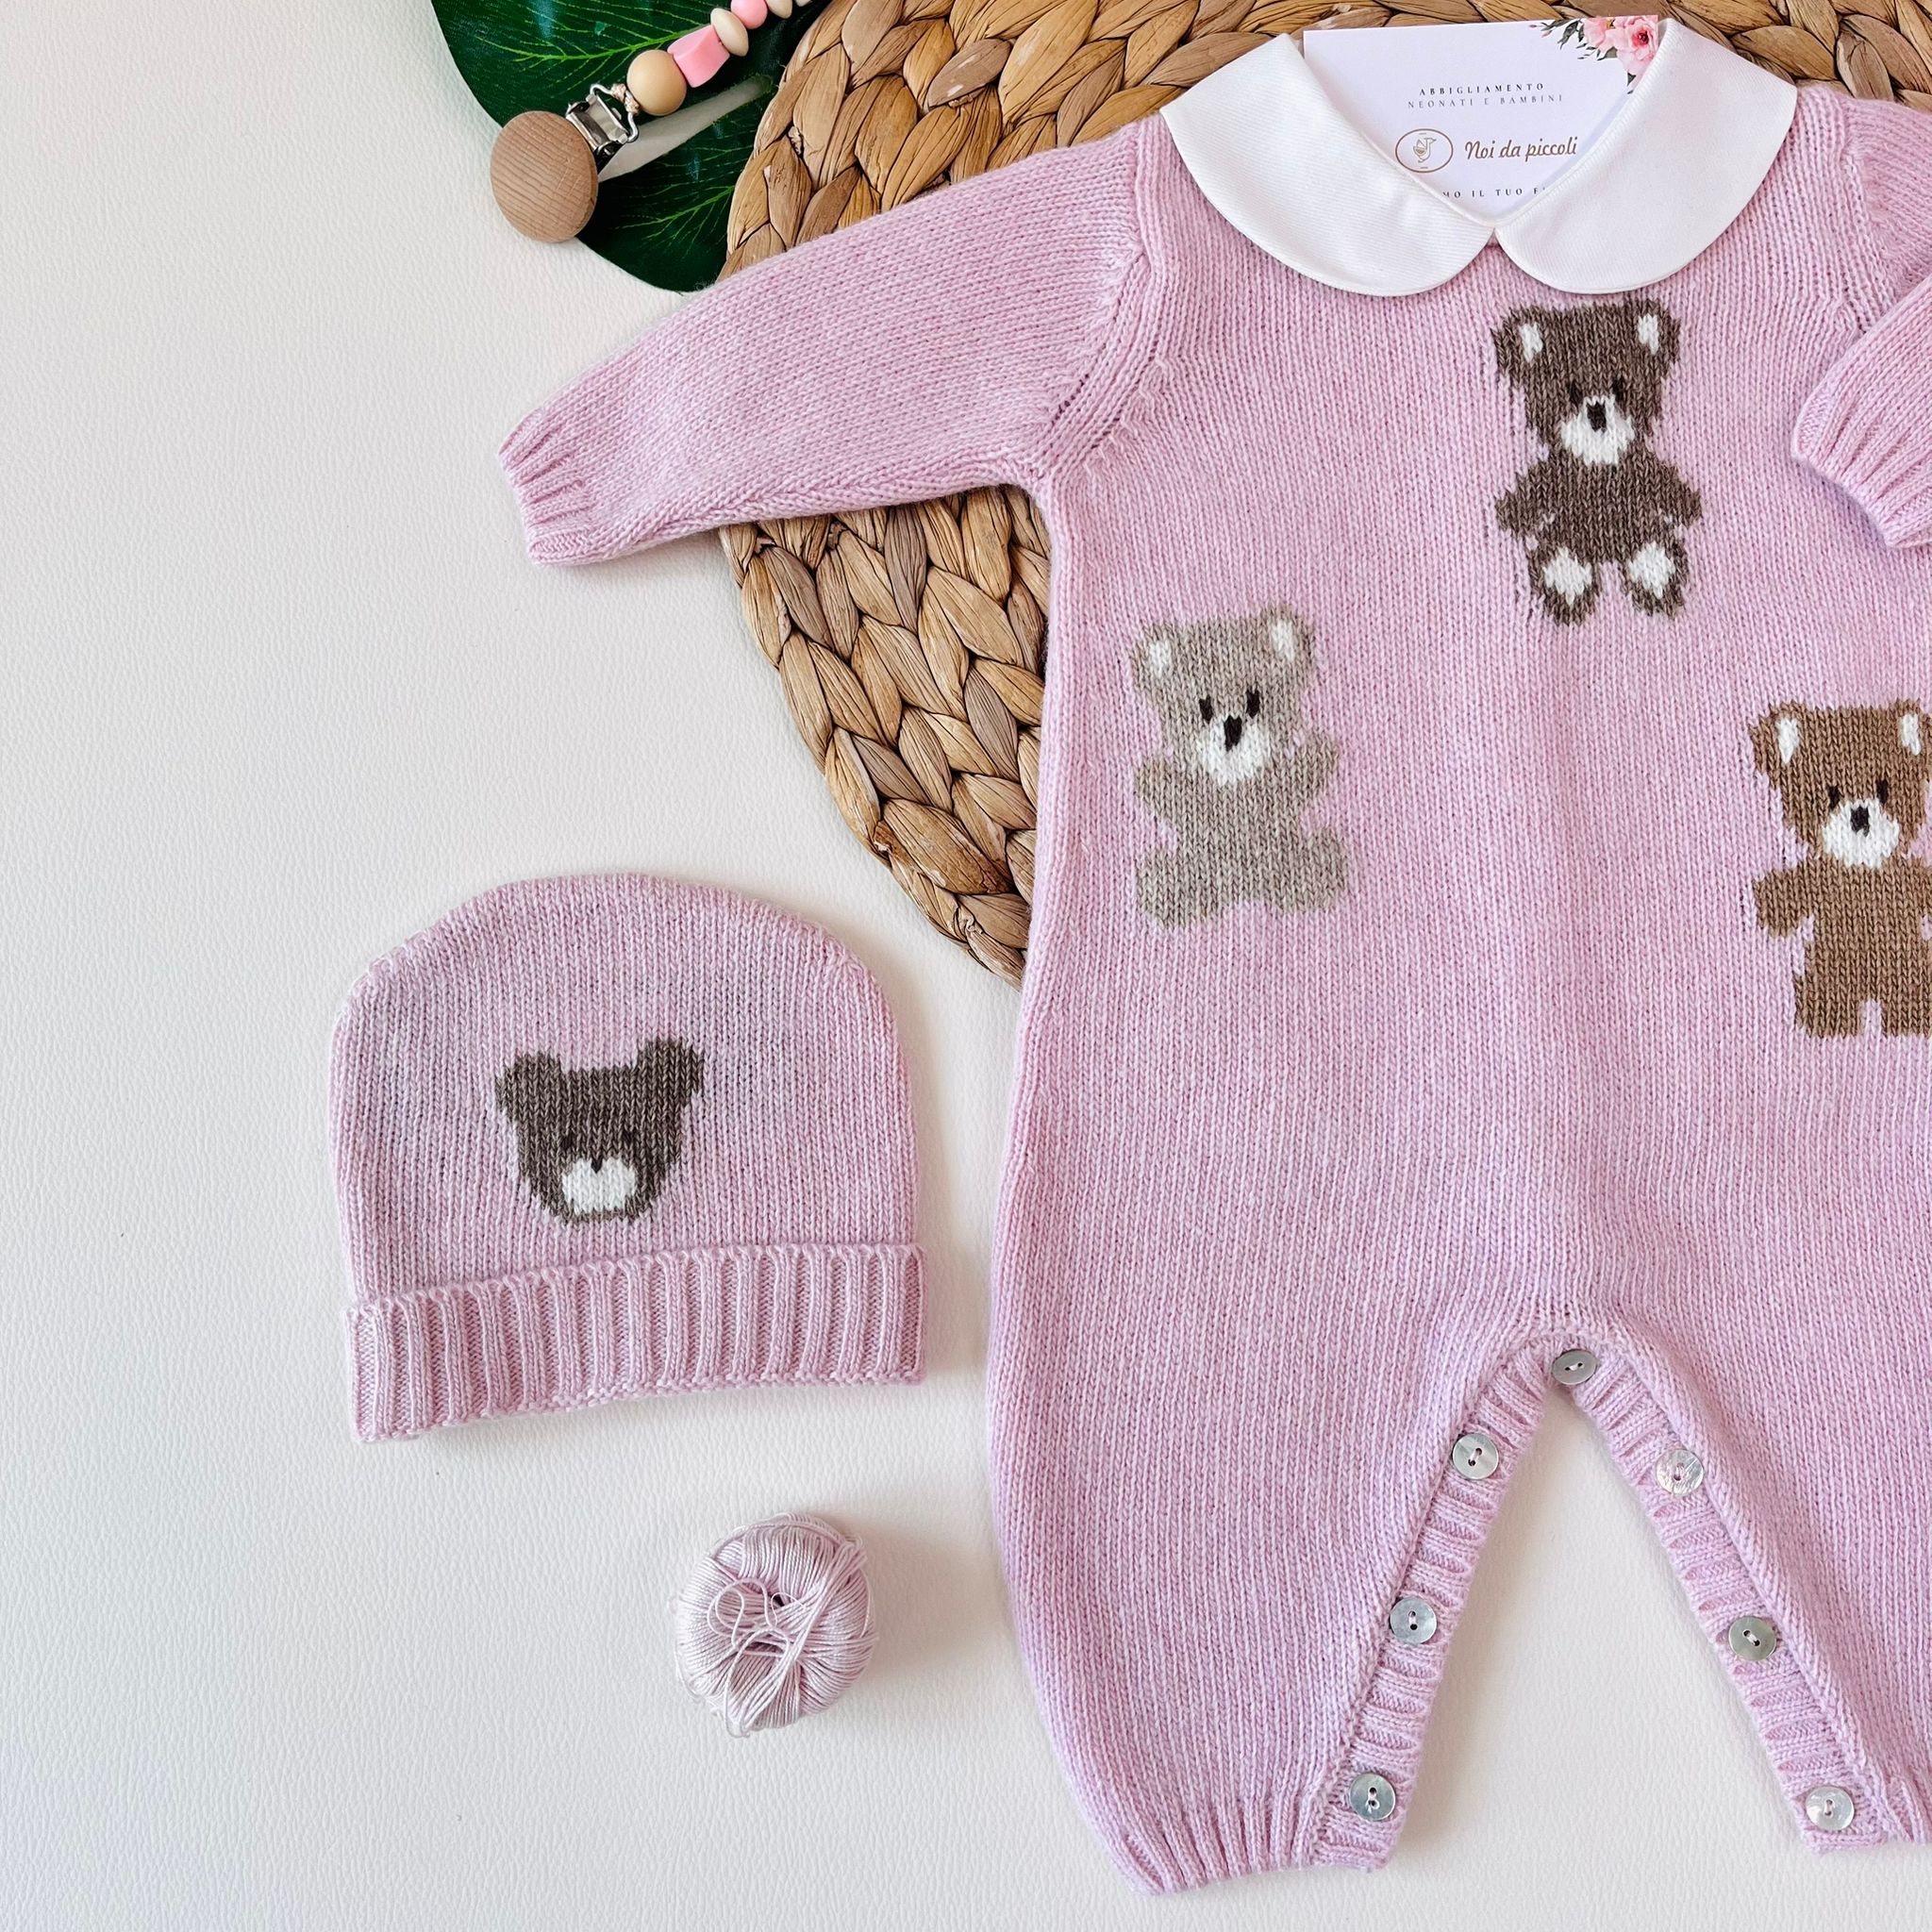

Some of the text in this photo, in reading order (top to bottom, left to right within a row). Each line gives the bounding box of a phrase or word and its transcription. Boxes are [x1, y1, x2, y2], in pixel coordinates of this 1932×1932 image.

[1419, 83, 1543, 95] ABBIGLIAMENTO
[1408, 94, 1562, 109] NEONATI E BAMBINI
[1465, 136, 1578, 162] Noi da piccoli
[1495, 188, 1523, 196] TUO
